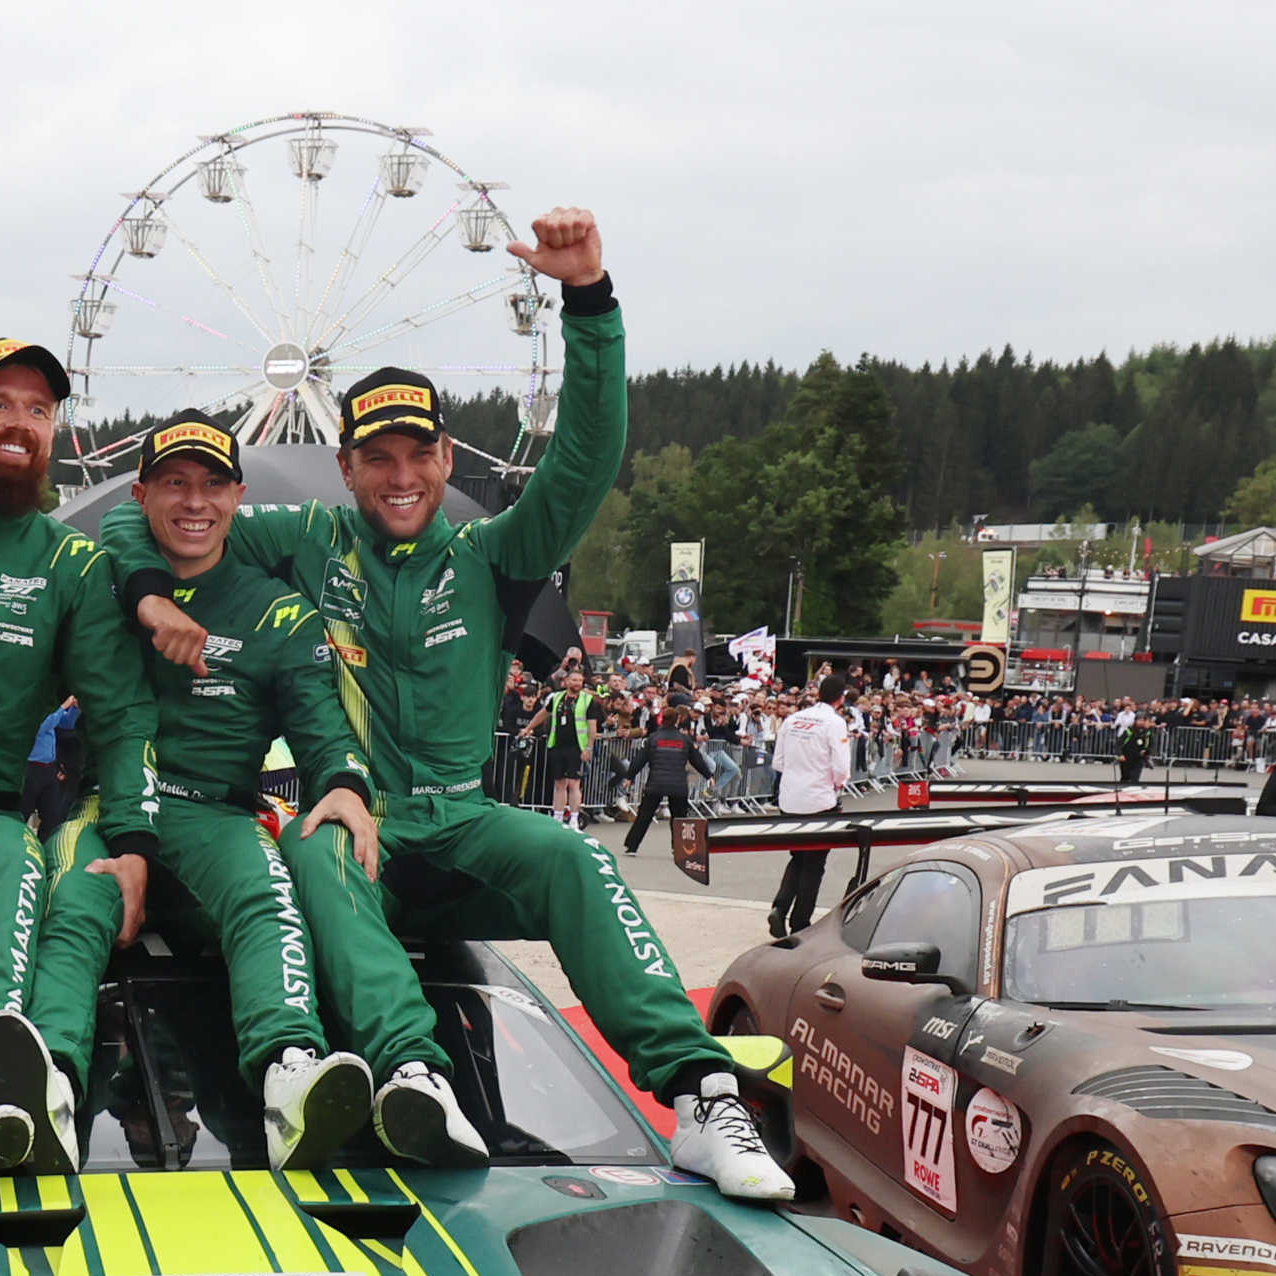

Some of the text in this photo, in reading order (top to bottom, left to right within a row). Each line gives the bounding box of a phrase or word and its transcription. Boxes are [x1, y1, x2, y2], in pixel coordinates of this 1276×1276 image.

[358, 389, 425, 411] PIRELLI
[160, 427, 225, 446] PIRELLI
[208, 635, 243, 648] NATEC
[412, 785, 443, 795] MARCO
[907, 784, 922, 798] aws
[681, 822, 696, 840] aws
[11, 860, 43, 983] MARTIN
[605, 882, 673, 978] ASTON
[279, 925, 310, 1014] ASTON
[870, 960, 916, 972] AMG
[790, 1017, 894, 1119] ALMANAR
[801, 1053, 880, 1135] RACING
[907, 1091, 947, 1166] 777
[914, 1160, 940, 1192] ROWE
[1100, 1151, 1147, 1204] ZERO
